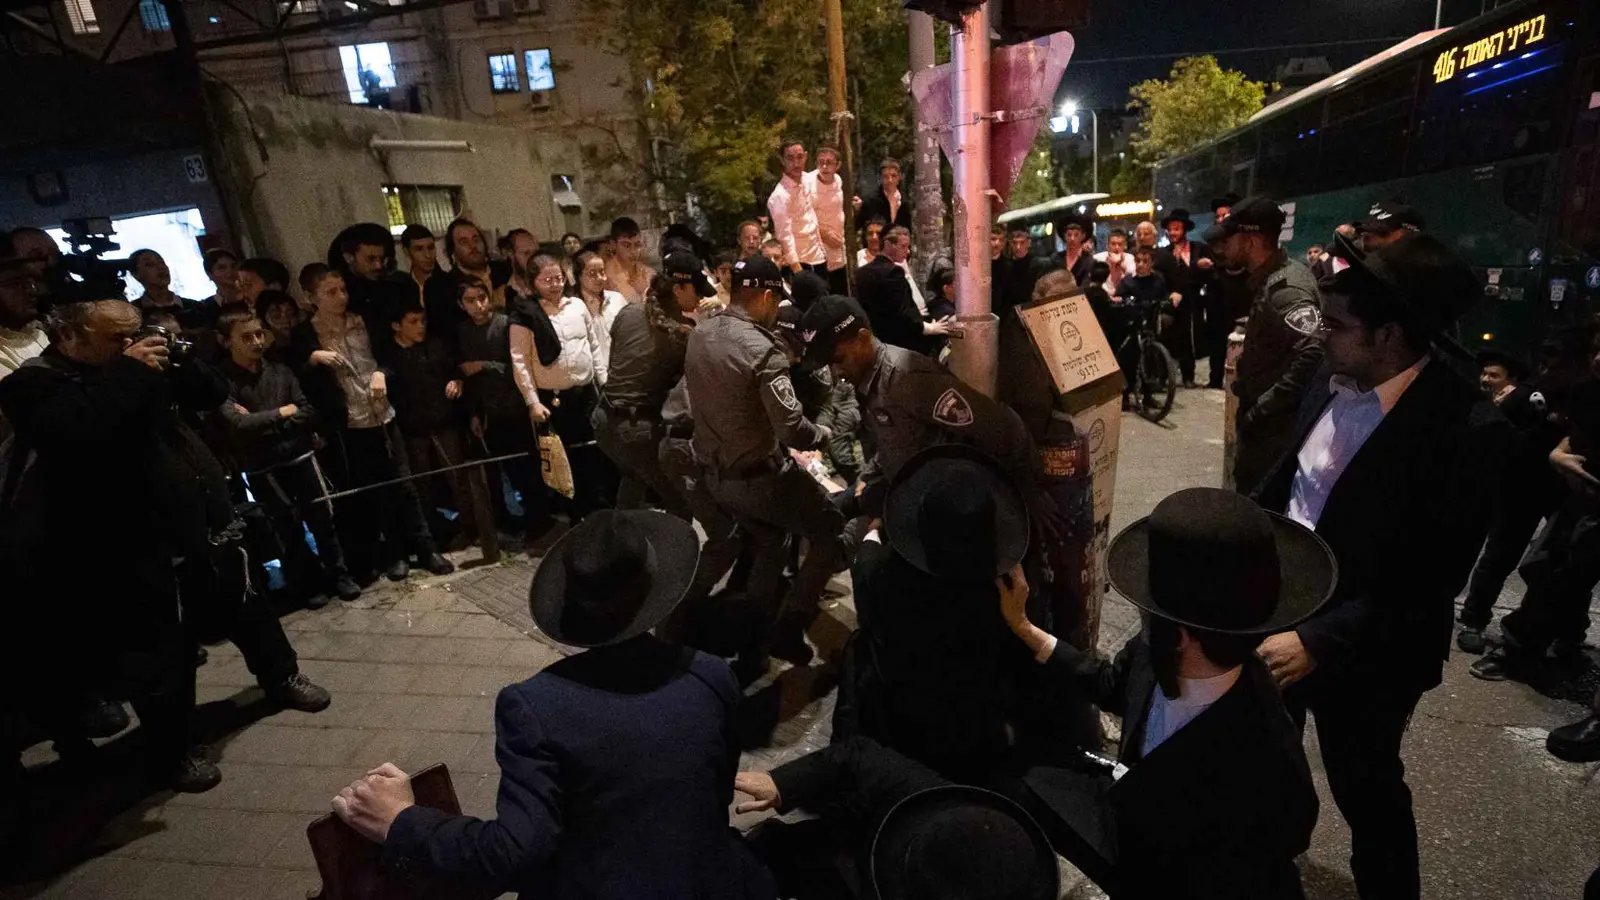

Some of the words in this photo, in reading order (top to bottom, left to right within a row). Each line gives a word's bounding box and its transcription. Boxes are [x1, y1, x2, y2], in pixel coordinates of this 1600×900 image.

[1459, 31, 1504, 70] האומה
[1507, 14, 1546, 51] בנייני
[1432, 46, 1458, 84] 416
[186, 159, 205, 178] 63
